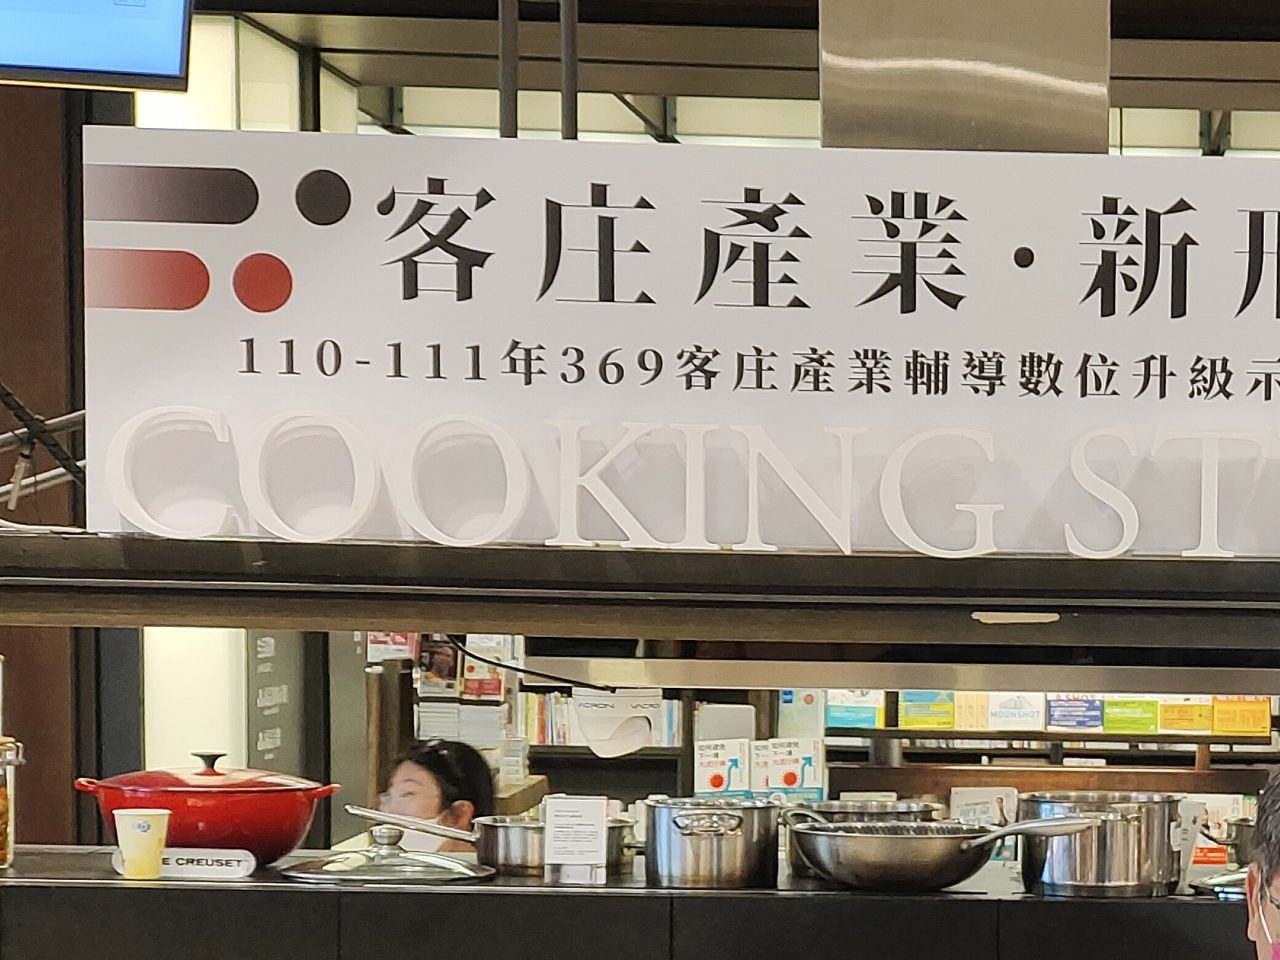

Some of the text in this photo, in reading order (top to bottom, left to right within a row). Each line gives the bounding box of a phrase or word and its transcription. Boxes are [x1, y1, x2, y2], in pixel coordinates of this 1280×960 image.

[108, 405, 1001, 556] COOKING
[990, 709, 1041, 719] MOONSHOT
[175, 857, 243, 868] CREUSET
